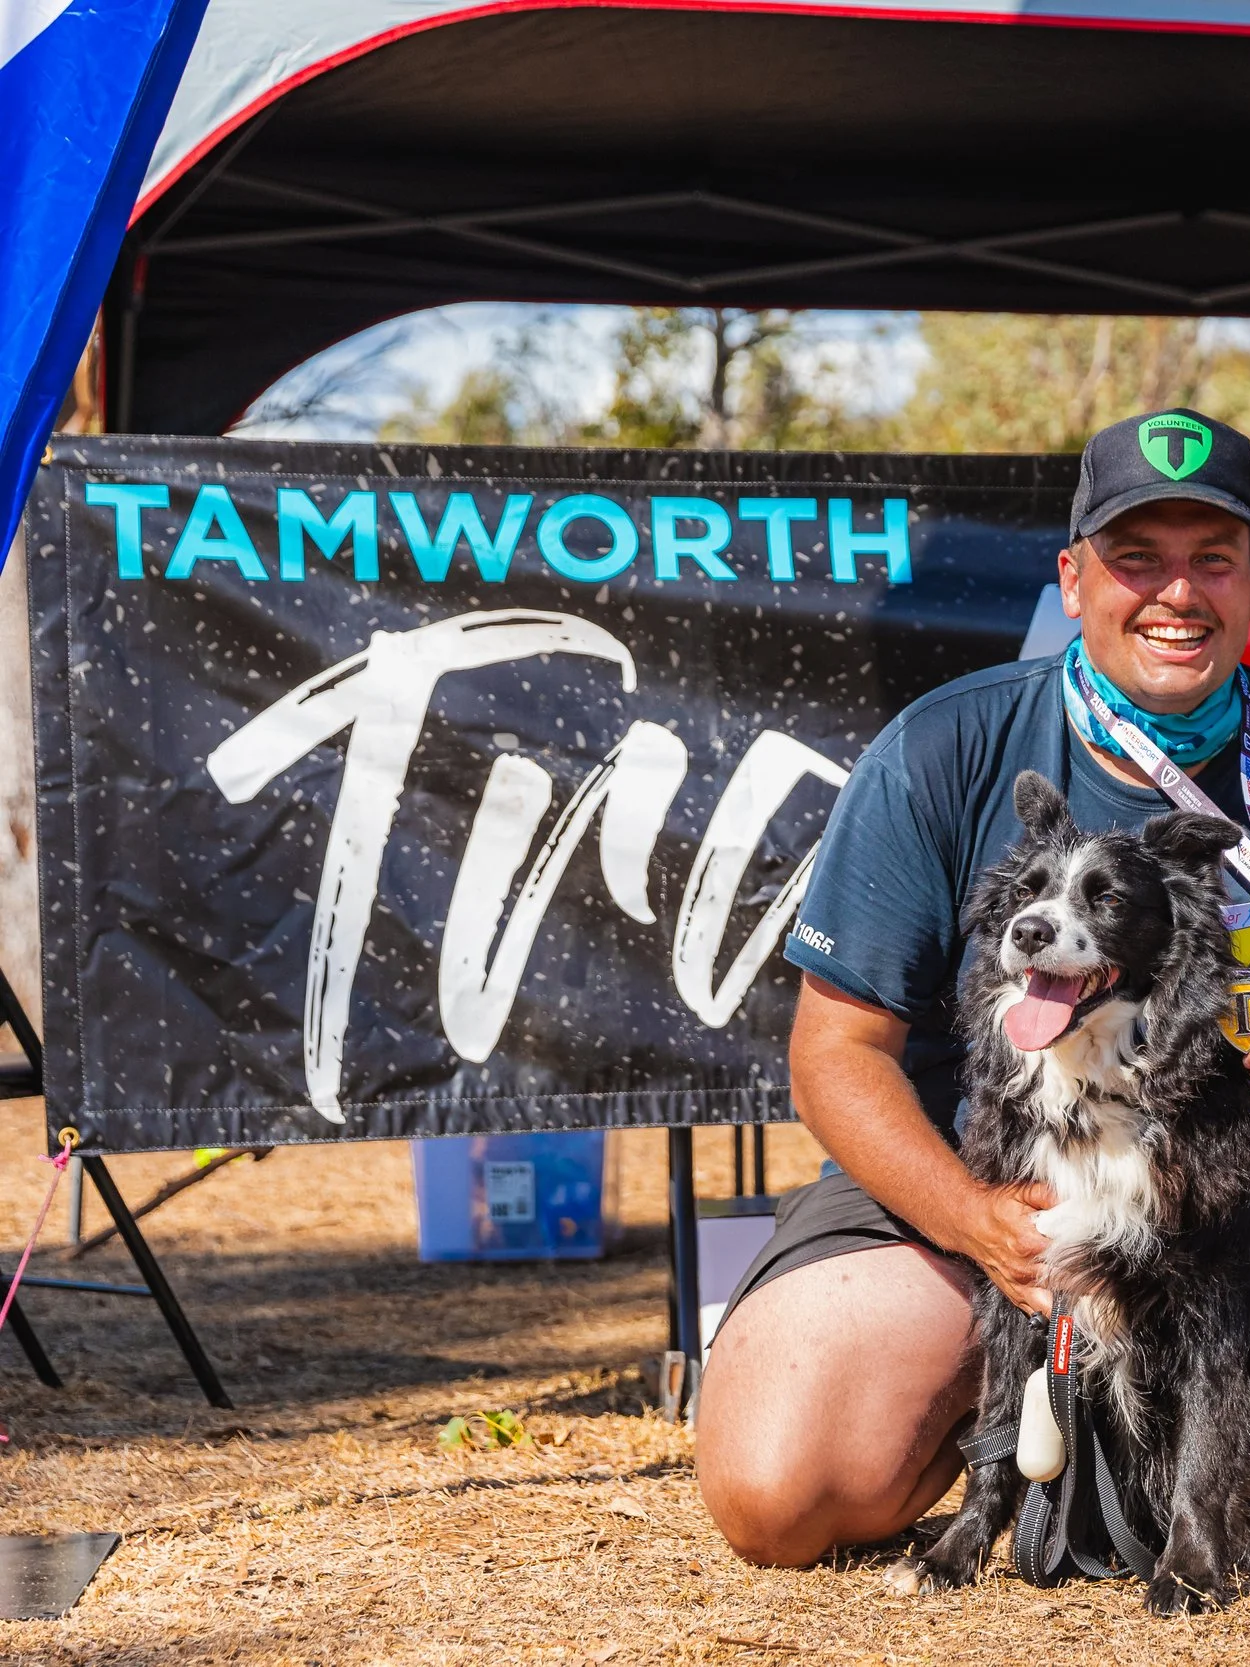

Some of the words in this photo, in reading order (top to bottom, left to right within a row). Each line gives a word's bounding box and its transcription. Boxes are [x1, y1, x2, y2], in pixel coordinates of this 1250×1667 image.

[1147, 419, 1204, 432] VOLUNTEER
[85, 483, 913, 584] TAMWORTH
[1089, 692, 1113, 722] 2026
[1122, 726, 1160, 763] INTERSPORT
